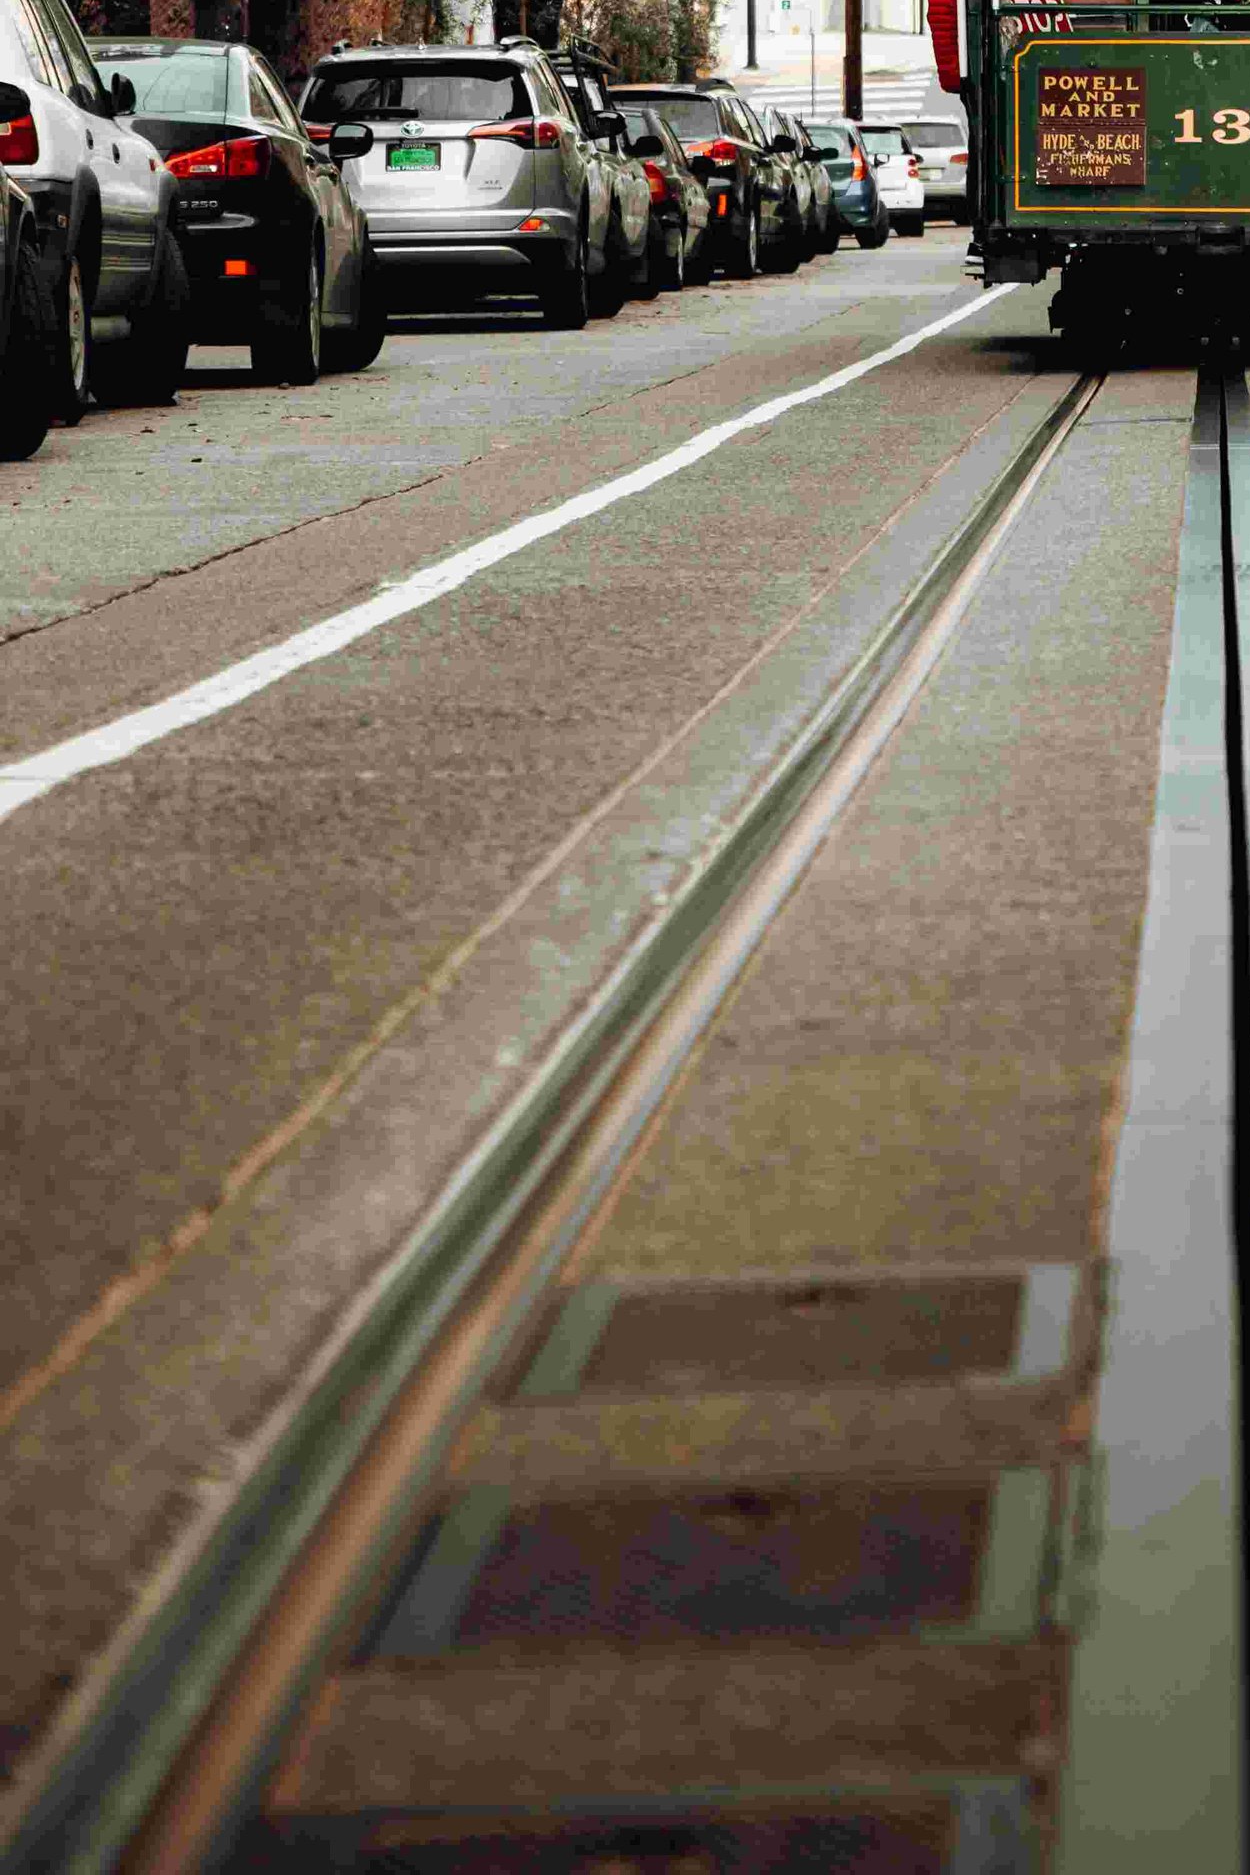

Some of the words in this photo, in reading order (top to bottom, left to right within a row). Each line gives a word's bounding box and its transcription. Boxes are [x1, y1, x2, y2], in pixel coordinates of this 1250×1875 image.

[1043, 75, 1140, 91] POWELL
[1068, 91, 1115, 102] AND
[1041, 103, 1141, 118] MARKET
[1043, 133, 1076, 150] HYDE
[1097, 133, 1140, 150] BEACH
[1069, 165, 1112, 177] WHARF
[190, 200, 218, 209] 250
